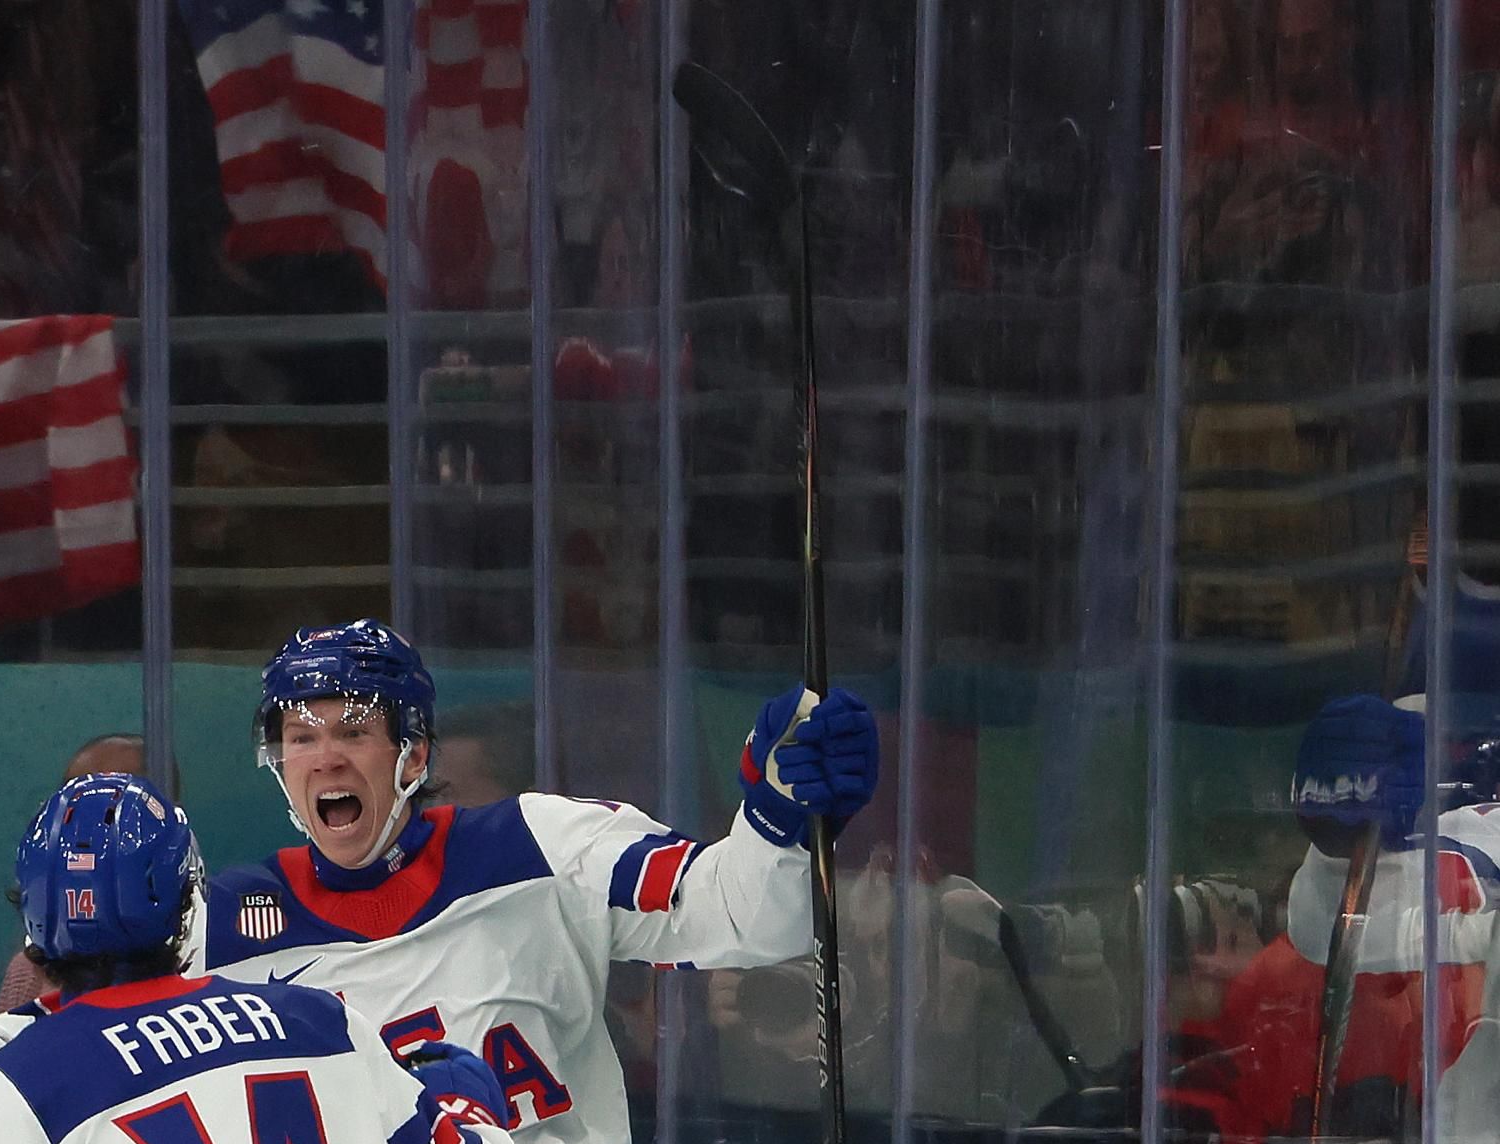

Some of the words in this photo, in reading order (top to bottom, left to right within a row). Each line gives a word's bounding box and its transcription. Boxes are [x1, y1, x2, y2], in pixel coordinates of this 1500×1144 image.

[65, 889, 96, 919] 14
[245, 895, 275, 906] USA
[101, 993, 287, 1075] FABER
